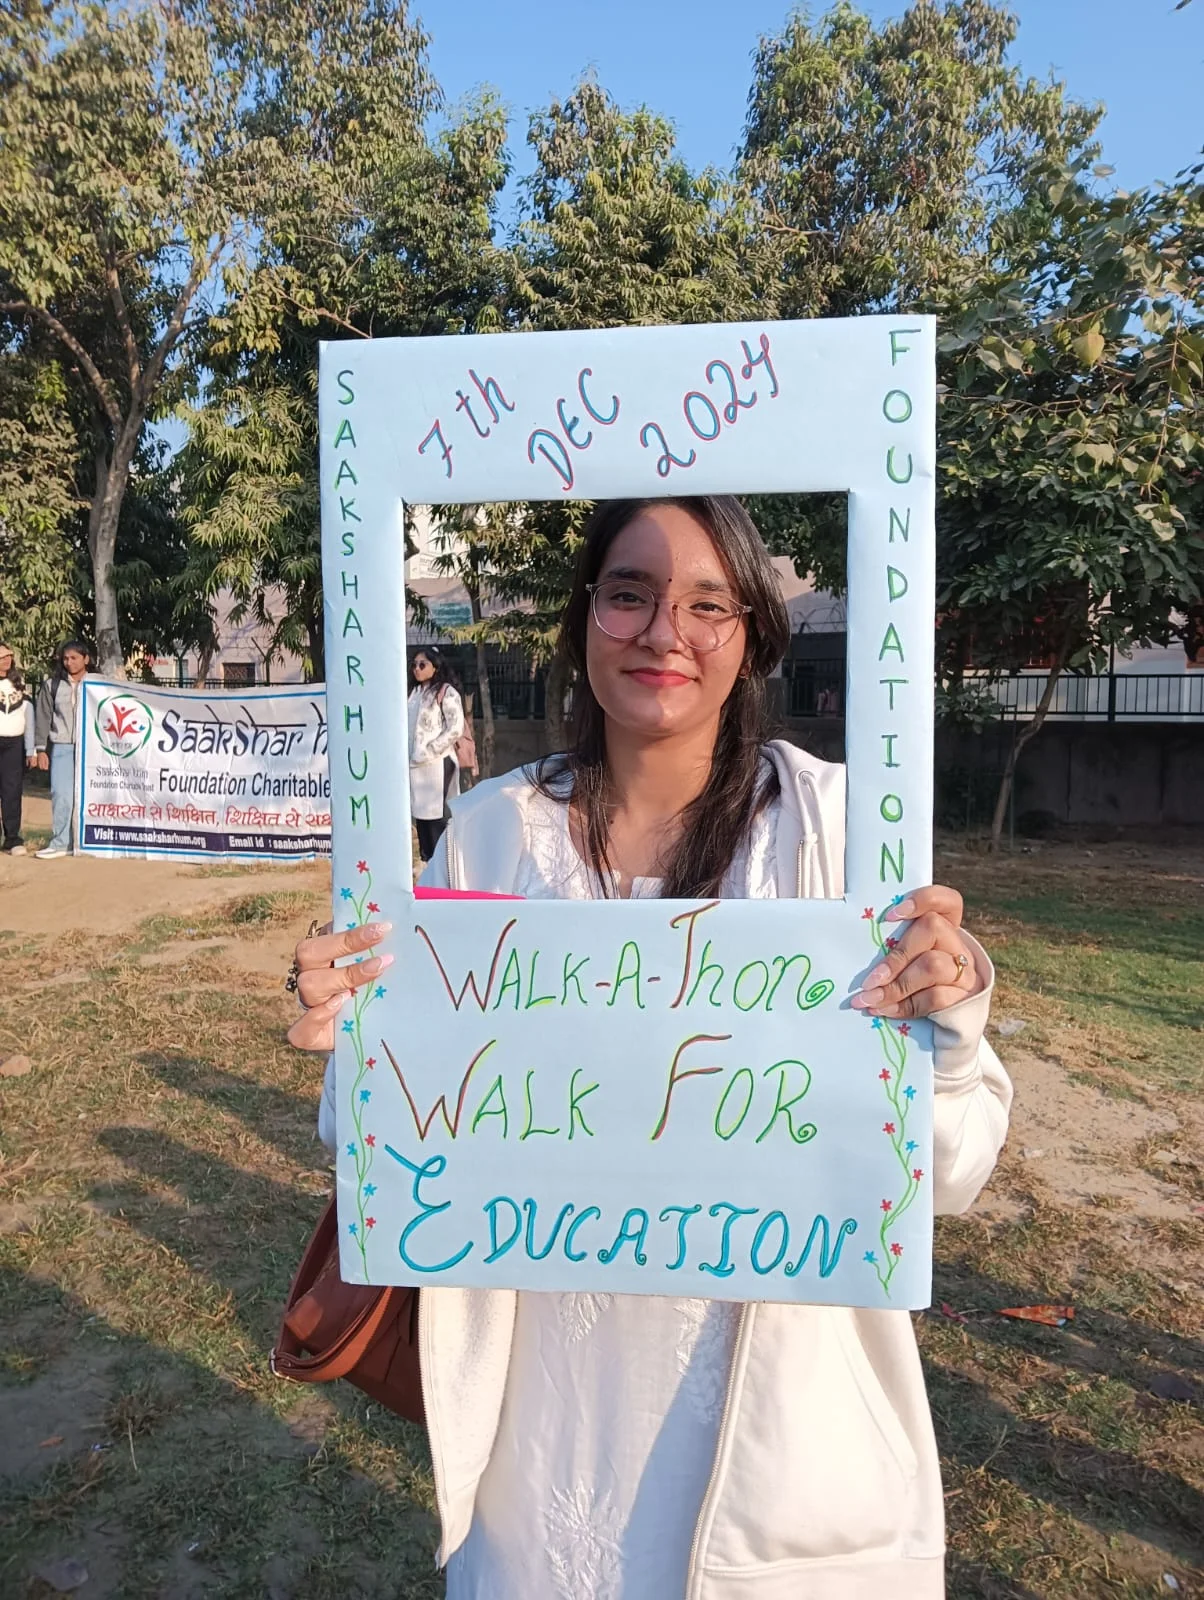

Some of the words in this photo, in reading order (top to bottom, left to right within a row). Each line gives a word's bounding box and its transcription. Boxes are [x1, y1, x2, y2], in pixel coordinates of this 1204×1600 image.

[417, 368, 515, 479] 7th
[527, 368, 620, 491] DEC
[639, 333, 780, 479] 2024
[335, 370, 371, 829] SAAKSHARHUM
[878, 329, 921, 883] FOUNDATION
[158, 703, 307, 757] SaakShar
[88, 802, 146, 820] साक्षरता
[150, 801, 162, 820] से
[225, 805, 281, 828] शिक्षित
[286, 807, 302, 828] से
[159, 767, 247, 797] Foundation
[251, 771, 331, 799] Charitable
[93, 828, 114, 841] Visit
[119, 830, 207, 849] www.saaksharhum.org
[229, 835, 254, 848] Email
[255, 836, 265, 848] id
[380, 1039, 600, 1141] WALK
[650, 1033, 818, 1144] FOR
[384, 1144, 858, 1279] EDUCATION
